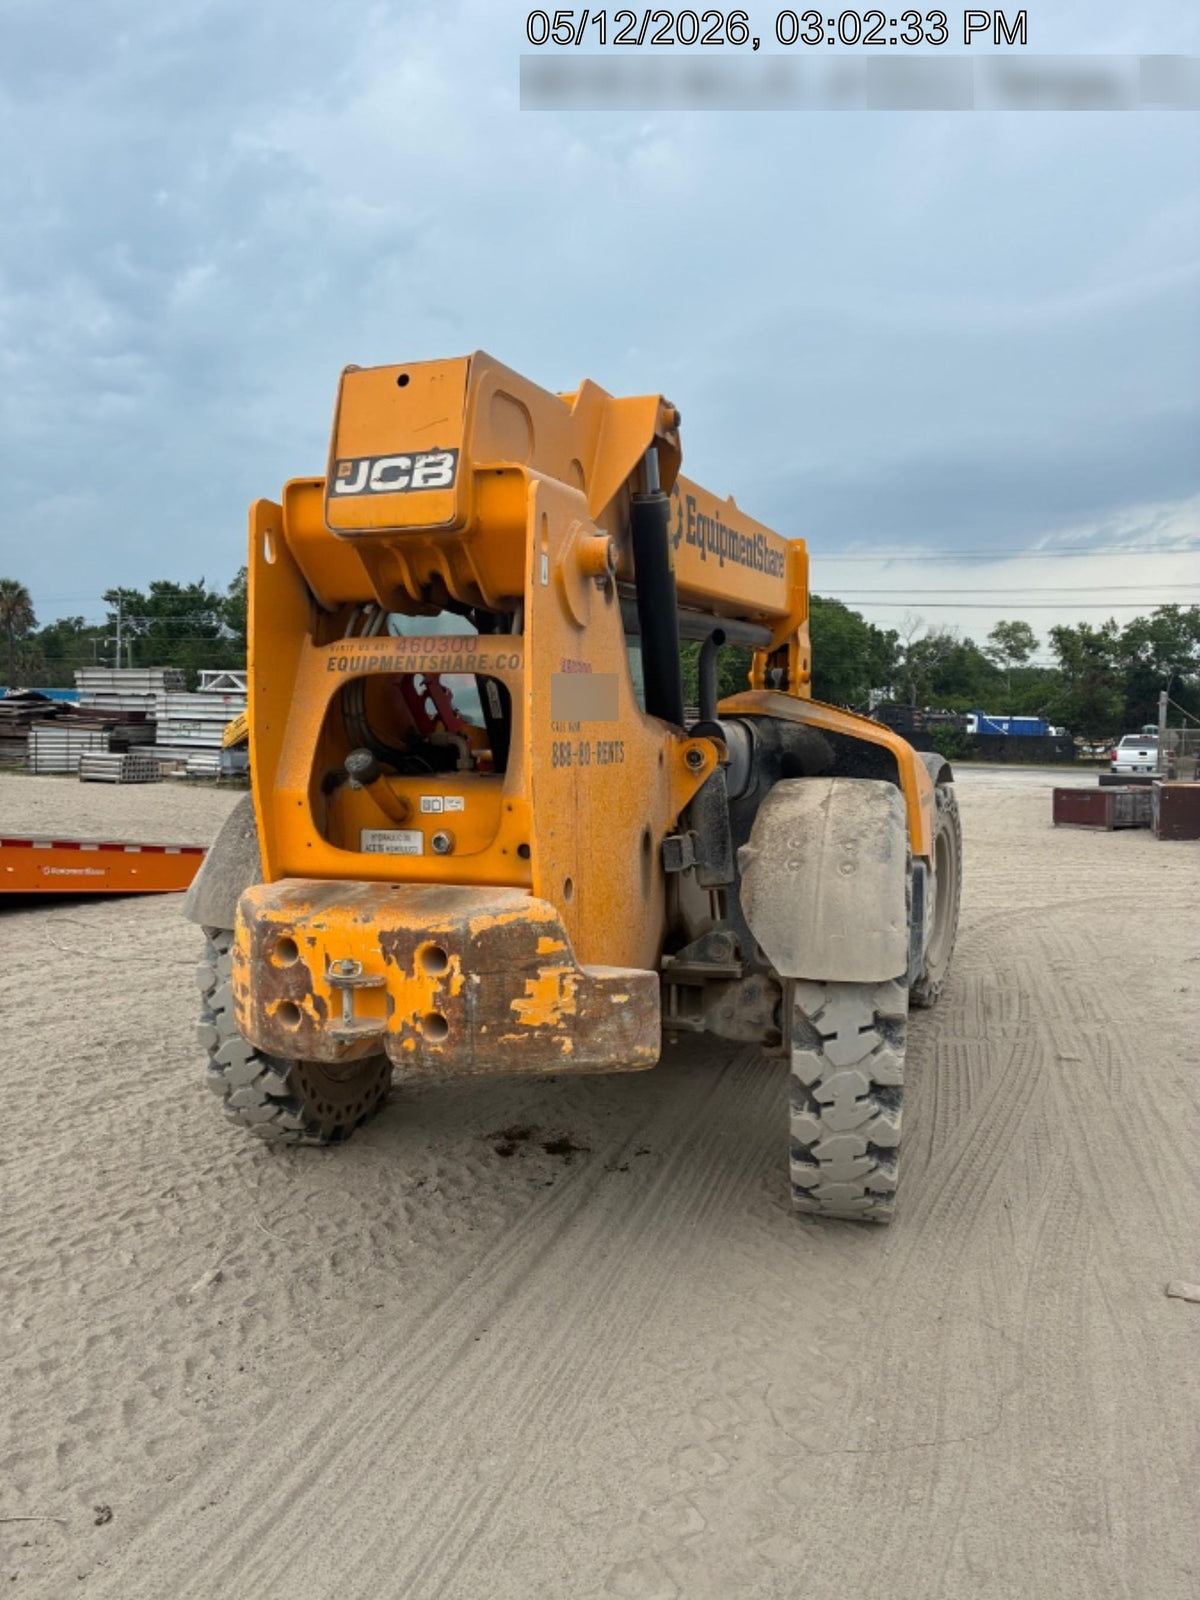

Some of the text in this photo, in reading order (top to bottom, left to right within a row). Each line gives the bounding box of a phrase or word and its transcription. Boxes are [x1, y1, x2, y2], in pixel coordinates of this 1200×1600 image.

[335, 453, 454, 493] JCB
[686, 494, 784, 578] EquipmentShare
[395, 636, 478, 654] 460300
[327, 654, 523, 672] EQUIPMENTSHARE.CO
